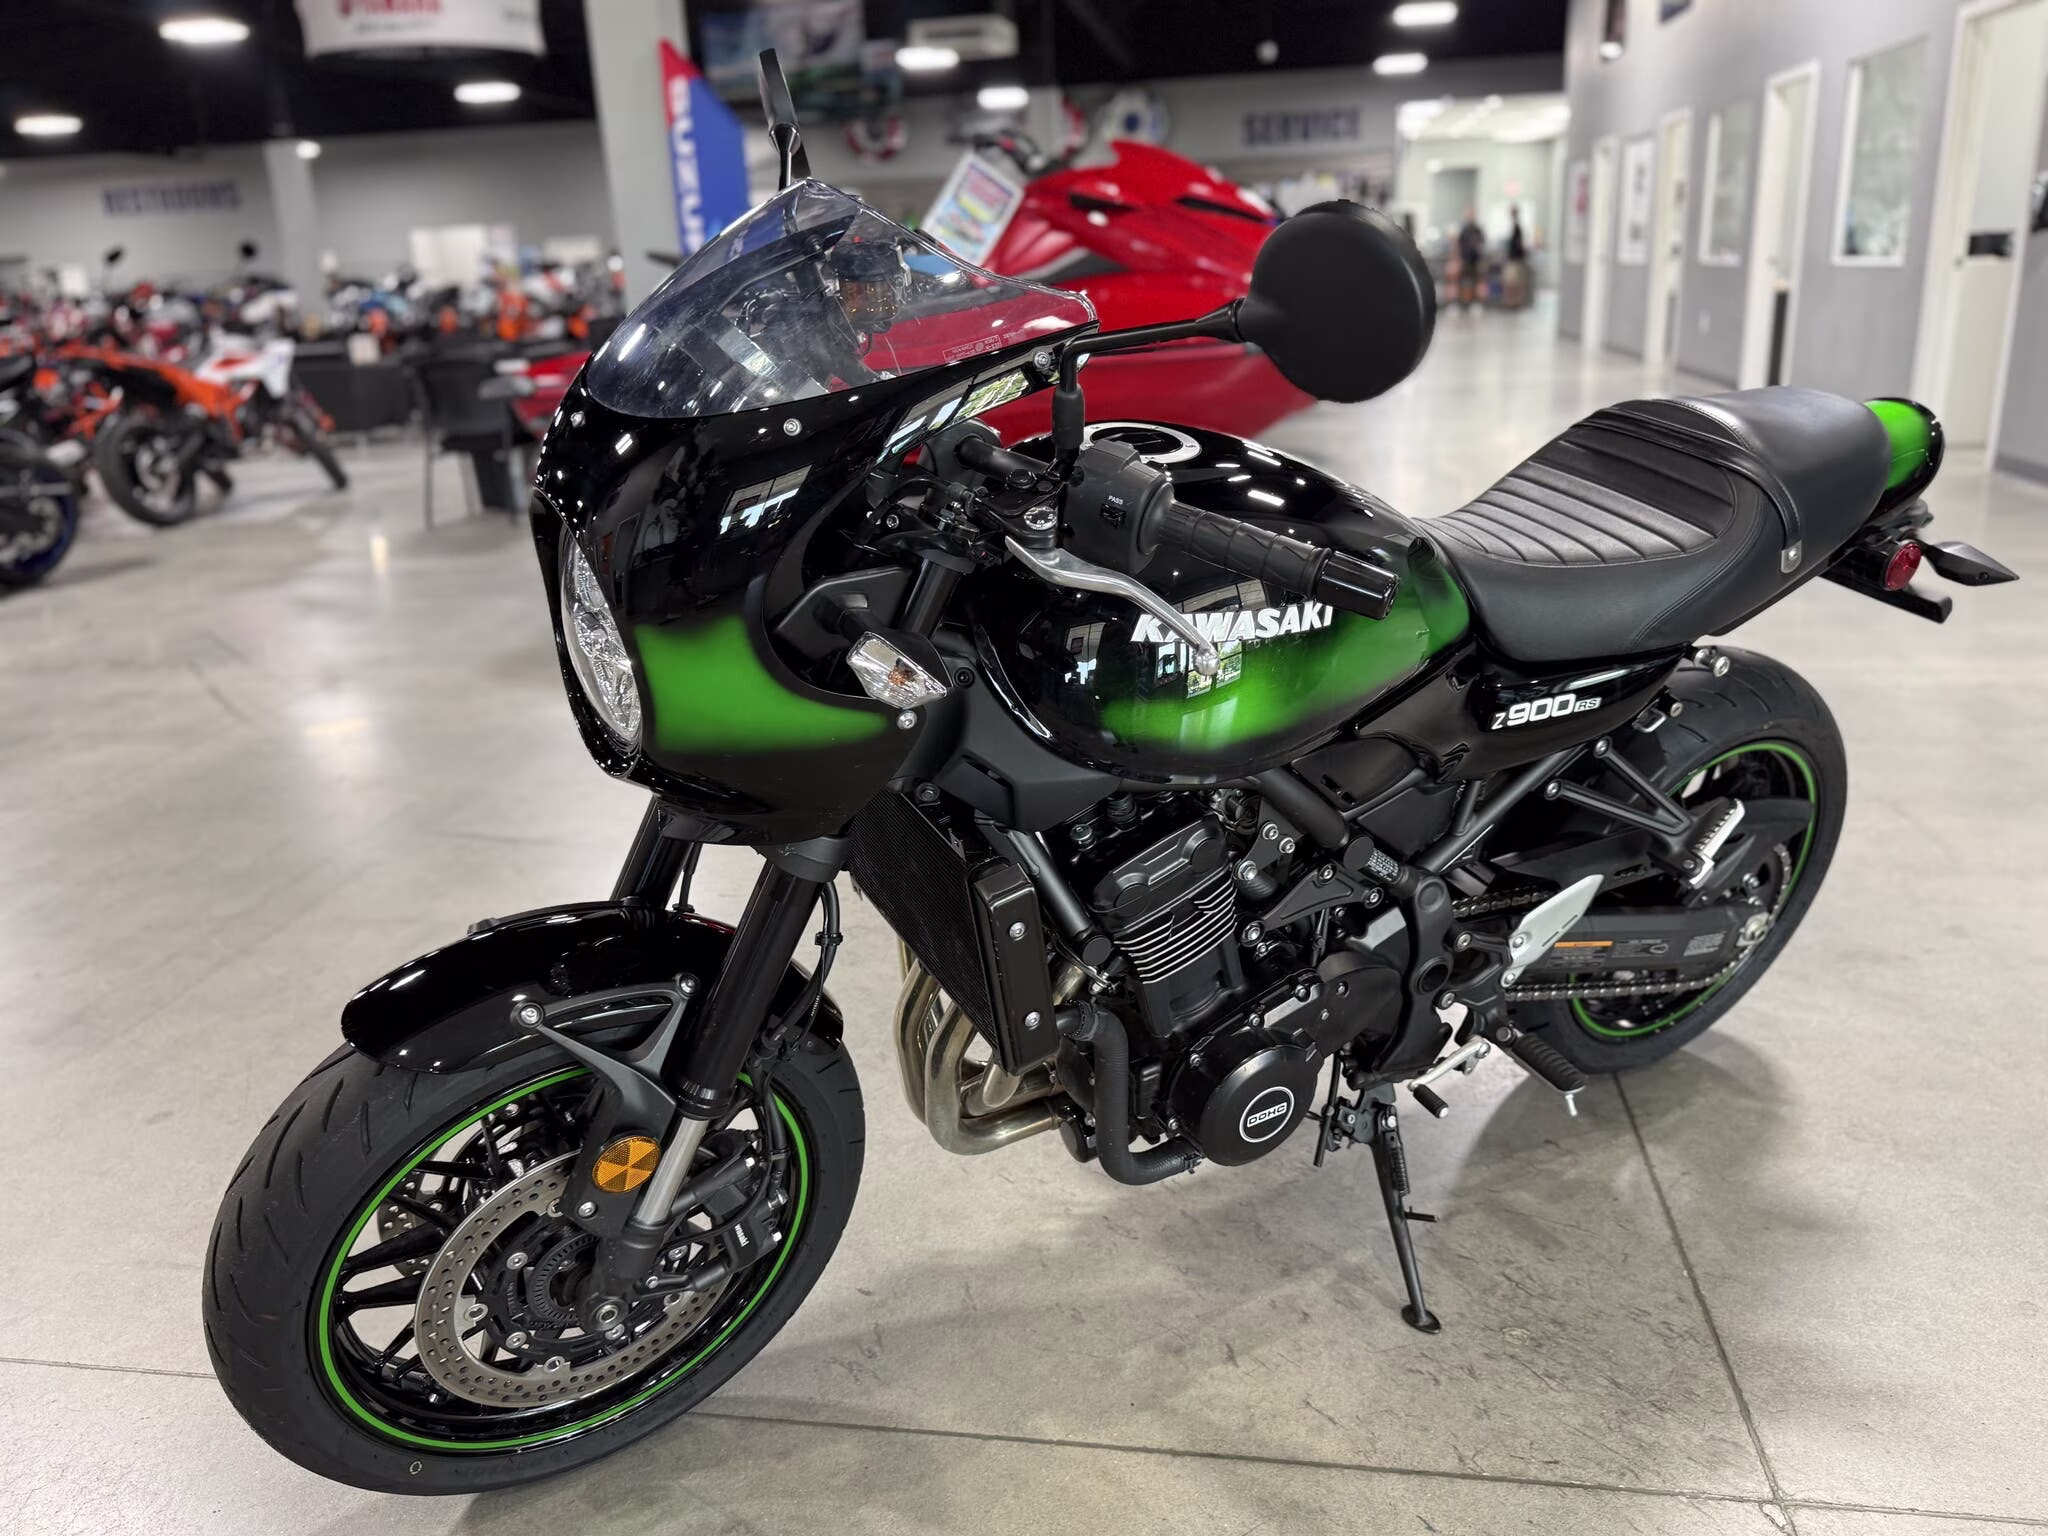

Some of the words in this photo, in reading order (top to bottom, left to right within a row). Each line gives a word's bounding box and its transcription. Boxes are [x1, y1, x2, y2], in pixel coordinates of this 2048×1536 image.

[1108, 495, 1124, 505] PASS
[1130, 600, 1334, 643] KWASAKI
[1248, 1105, 1286, 1125] DOHC
